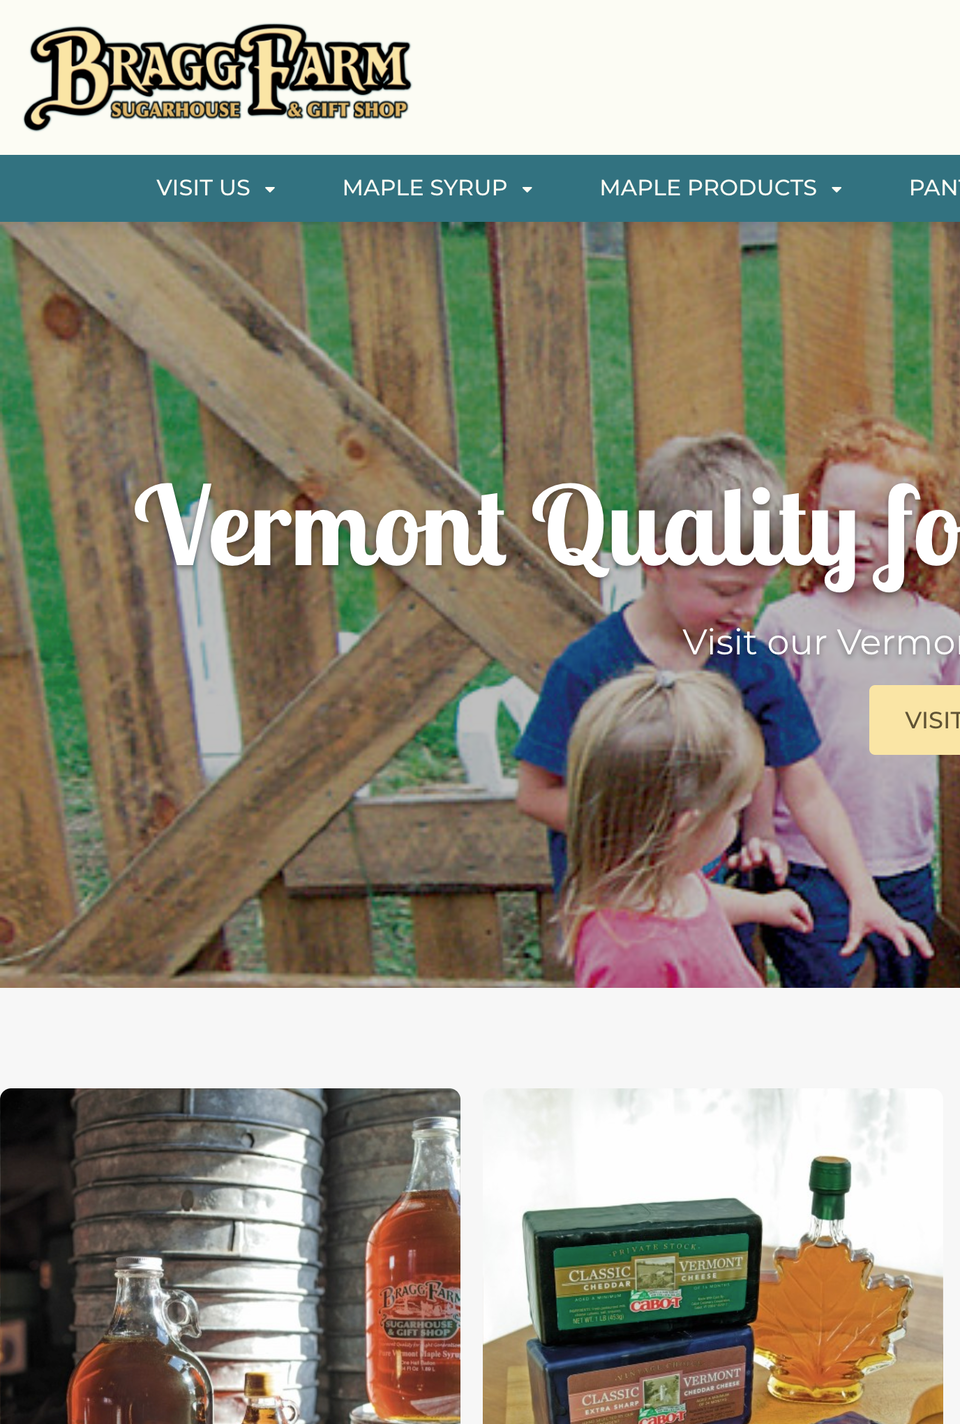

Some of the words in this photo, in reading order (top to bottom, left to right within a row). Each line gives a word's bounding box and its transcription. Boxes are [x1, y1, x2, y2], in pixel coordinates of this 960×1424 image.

[24, 26, 245, 130] BRAGG
[236, 24, 411, 116] FARM
[110, 101, 241, 118] SUGARHOUSE
[287, 101, 302, 118] &
[307, 101, 349, 118] GIFT
[353, 101, 408, 118] SHOP
[156, 178, 214, 197] VISIT
[220, 178, 251, 197] US
[343, 178, 424, 197] MAPLE
[430, 178, 508, 197] SYRUP
[601, 178, 681, 197] MAPLE
[688, 178, 817, 197] PRODUCTS
[679, 1256, 743, 1272] VERMONT
[569, 1266, 631, 1283] CLASSIC
[681, 1272, 718, 1282] CHEESE
[583, 1281, 631, 1291] CHEDDAR
[379, 1284, 426, 1314] BRAGG
[683, 1368, 742, 1387] VERMONT
[582, 1386, 639, 1406] CLASSIC
[684, 1385, 715, 1397] CHEDDAR
[717, 1380, 740, 1391] CHEESE
[585, 1405, 610, 1415] EXTRA
[614, 1400, 639, 1411] SHARP
